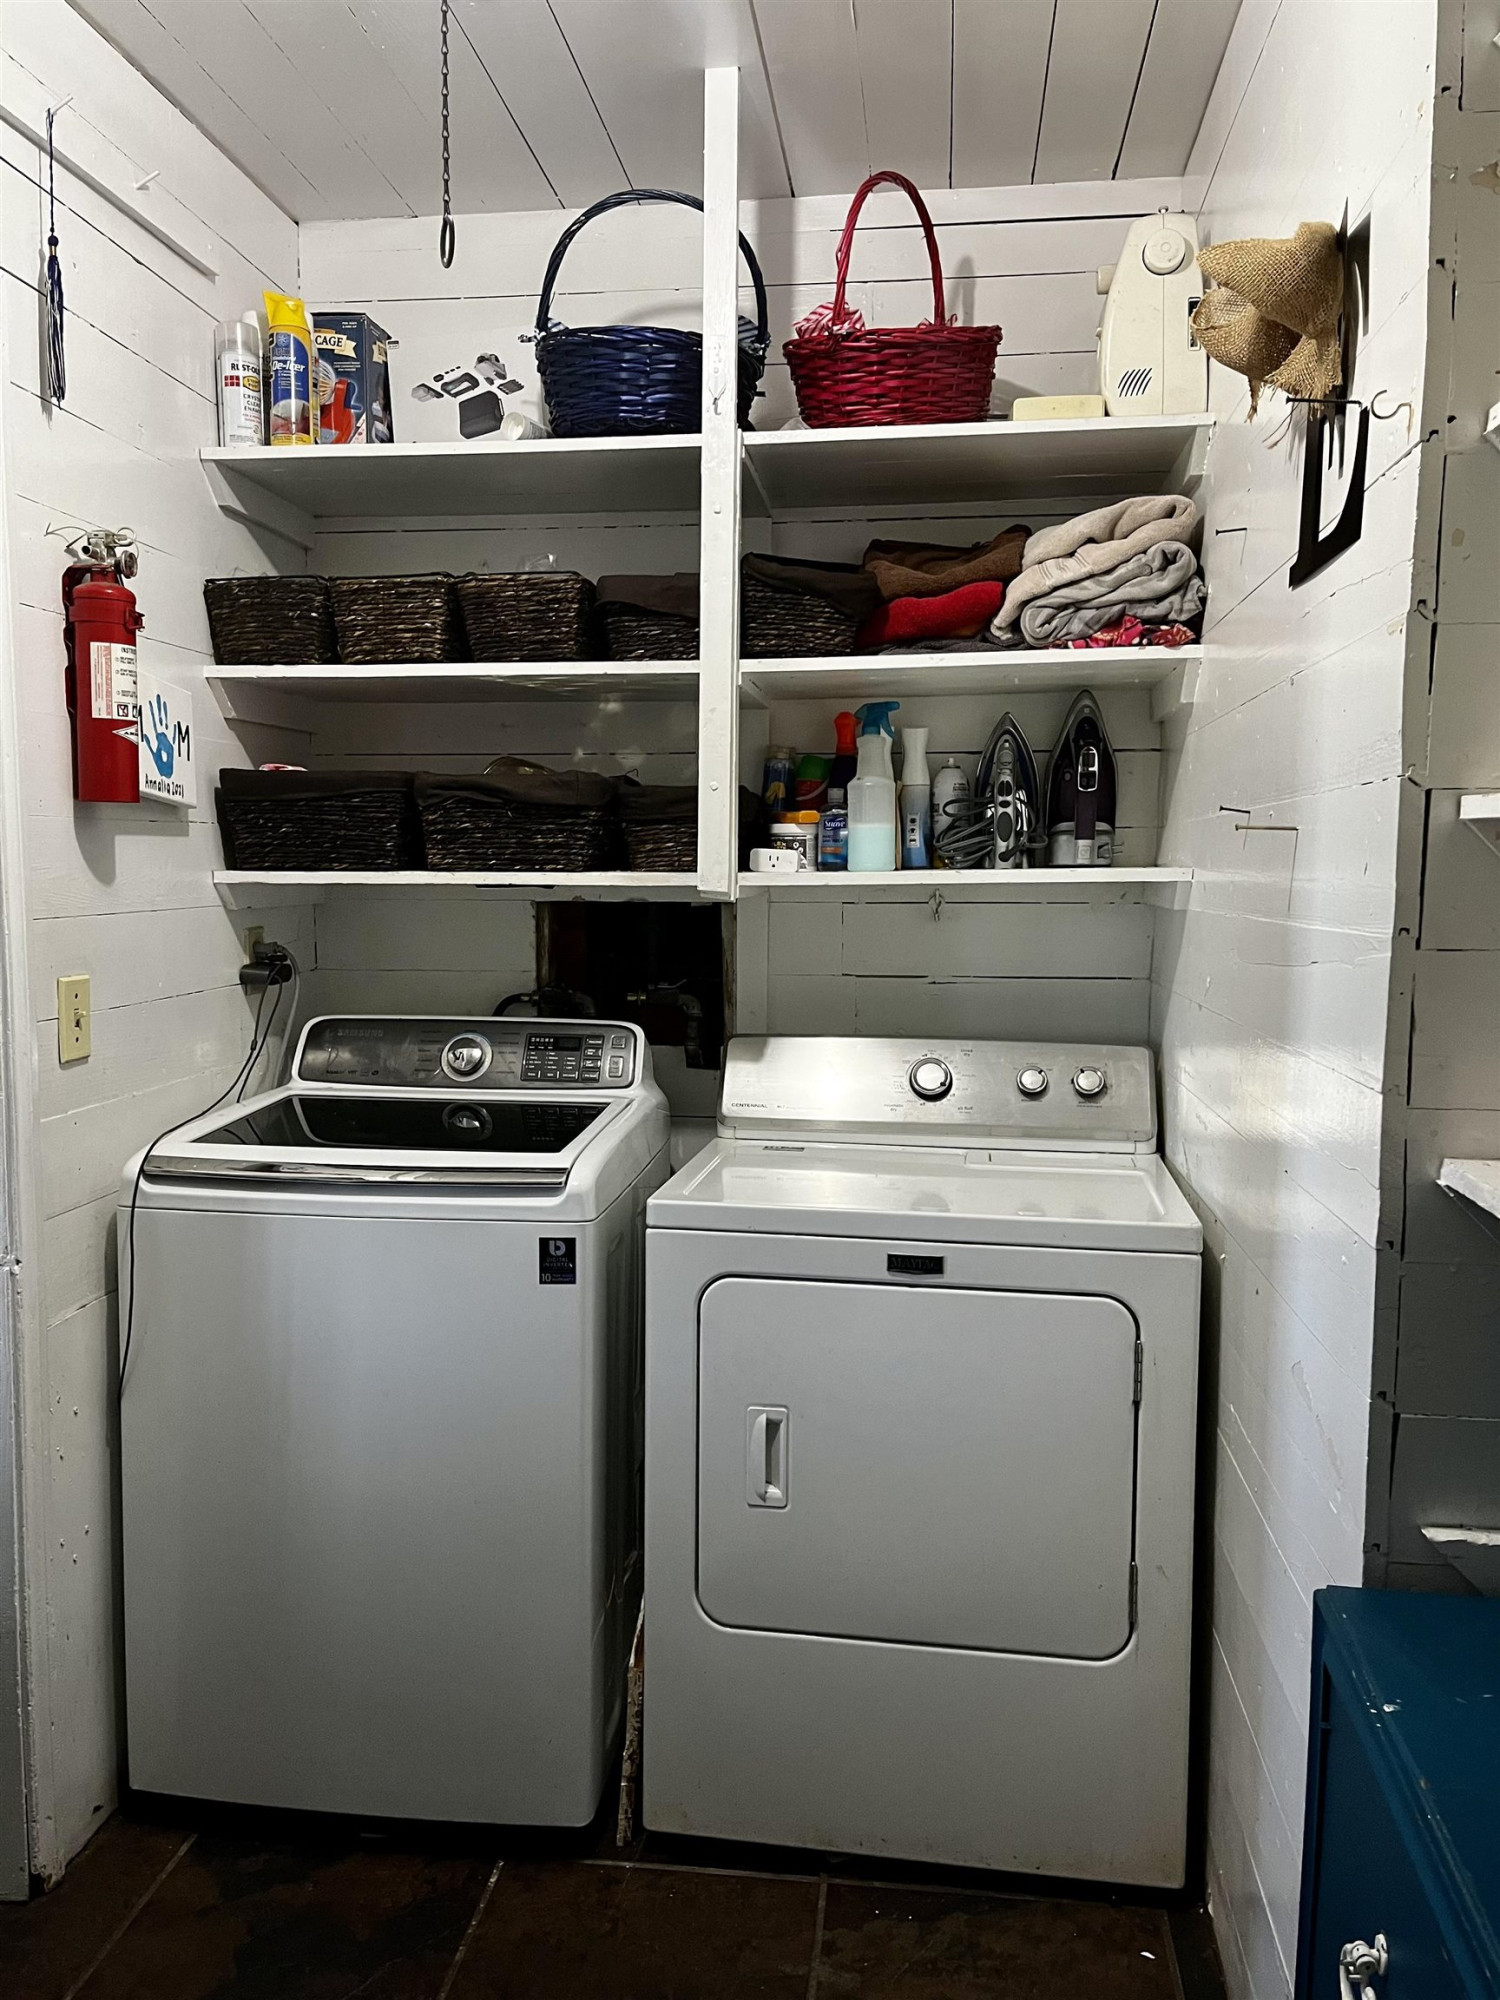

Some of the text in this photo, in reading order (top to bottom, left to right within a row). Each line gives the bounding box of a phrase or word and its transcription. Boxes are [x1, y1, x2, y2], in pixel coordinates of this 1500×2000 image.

[314, 335, 344, 348] CAGE
[824, 818, 846, 831] Suave
[541, 1273, 552, 1282] 10
